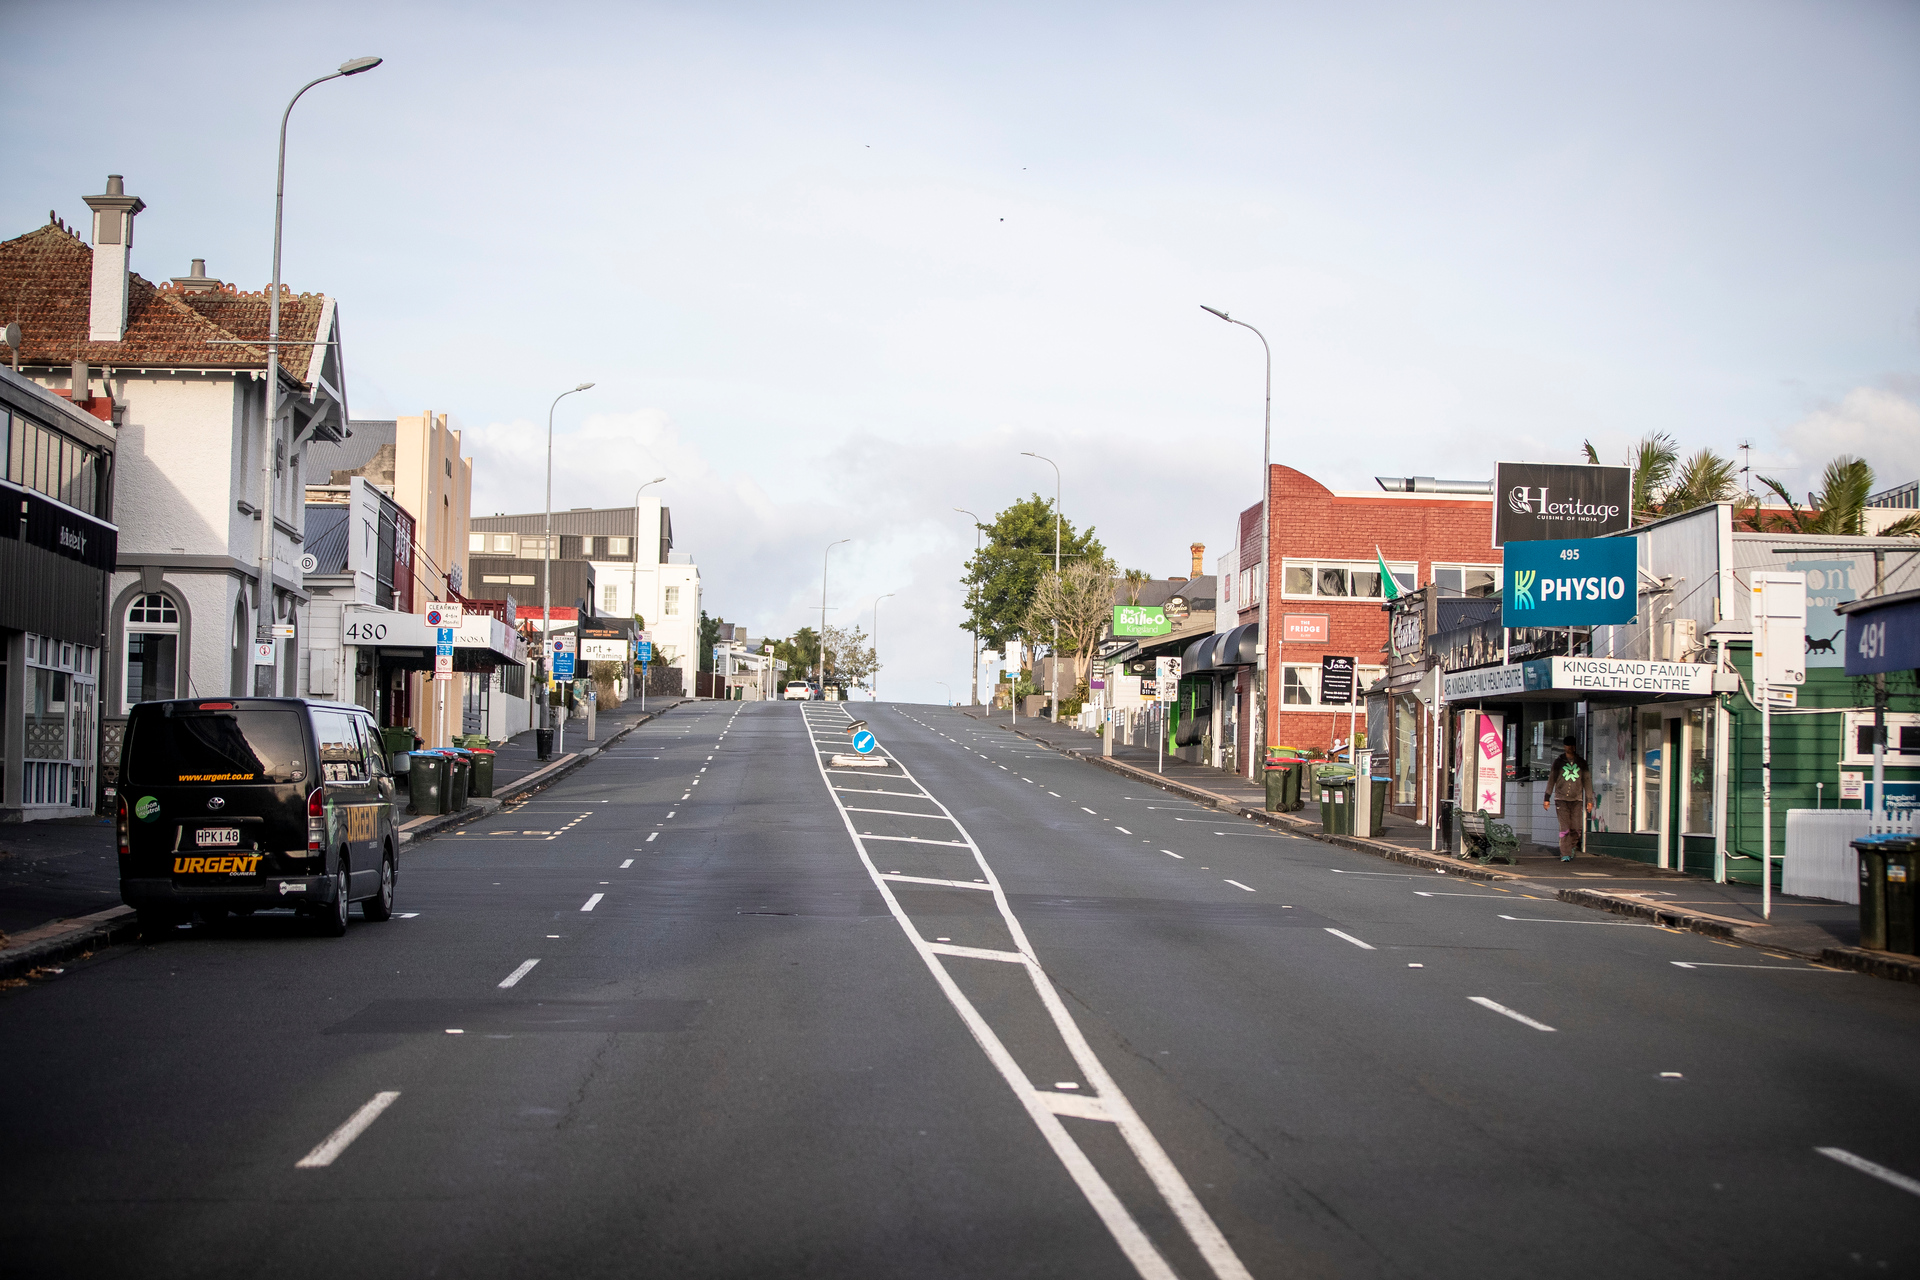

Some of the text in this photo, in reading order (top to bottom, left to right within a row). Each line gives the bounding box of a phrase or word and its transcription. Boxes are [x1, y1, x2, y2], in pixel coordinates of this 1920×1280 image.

[1510, 486, 1620, 524] Heritage
[1560, 549, 1580, 560] 495
[1802, 566, 1856, 591] ont
[1541, 576, 1625, 602] PHYSIO
[1805, 596, 1839, 608] oom
[1120, 608, 1165, 625] Bottle-O
[1123, 607, 1134, 615] the
[346, 623, 387, 641] 480
[1126, 625, 1159, 635] Kingsland
[453, 635, 485, 644] ENOSA
[1858, 621, 1886, 659] 491
[586, 645, 602, 653] art
[595, 652, 622, 660] framing
[1324, 659, 1353, 670] Jaan
[1563, 661, 1701, 677] KINGSLAND FAMILY
[1142, 680, 1156, 689] TH
[1452, 675, 1474, 695] KINGSLAND
[1474, 673, 1488, 693] FAMILY
[1488, 671, 1503, 690] HEALTH
[1503, 668, 1522, 688] CENTRE
[1573, 675, 1690, 691] HEALTH CENTRE
[178, 773, 254, 782] www.urgent.co.nz
[136, 801, 158, 812] carbon
[138, 805, 160, 817] neutral
[347, 806, 378, 843] URGENT
[197, 831, 239, 843] HPK148
[173, 855, 263, 873] URGENT
